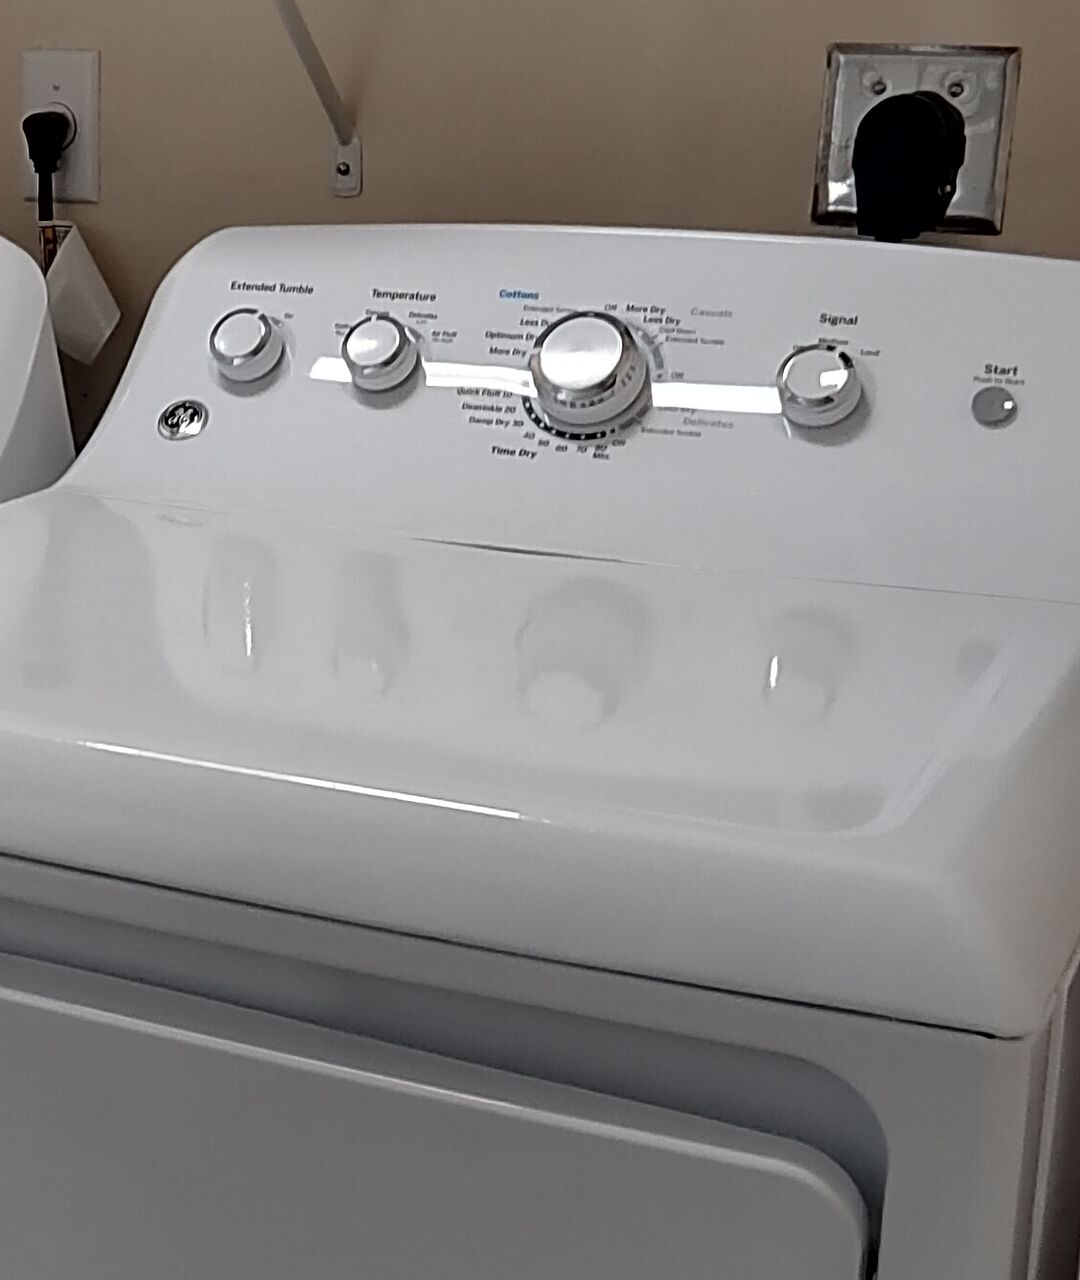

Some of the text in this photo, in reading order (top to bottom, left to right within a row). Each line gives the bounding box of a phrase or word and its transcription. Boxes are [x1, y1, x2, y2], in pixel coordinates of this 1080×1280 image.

[230, 281, 314, 295] Extended Tumble
[372, 288, 437, 302] Temperature
[499, 289, 539, 300] Cottons
[626, 304, 666, 315] More Dry
[664, 316, 681, 326] Dry
[819, 313, 858, 326] Signal
[485, 330, 523, 340] Optimum
[488, 346, 527, 357] More Dry
[983, 363, 1019, 376] Start
[468, 416, 493, 425] Damp
[495, 418, 510, 428] Dry
[491, 446, 538, 459] Time Dry
